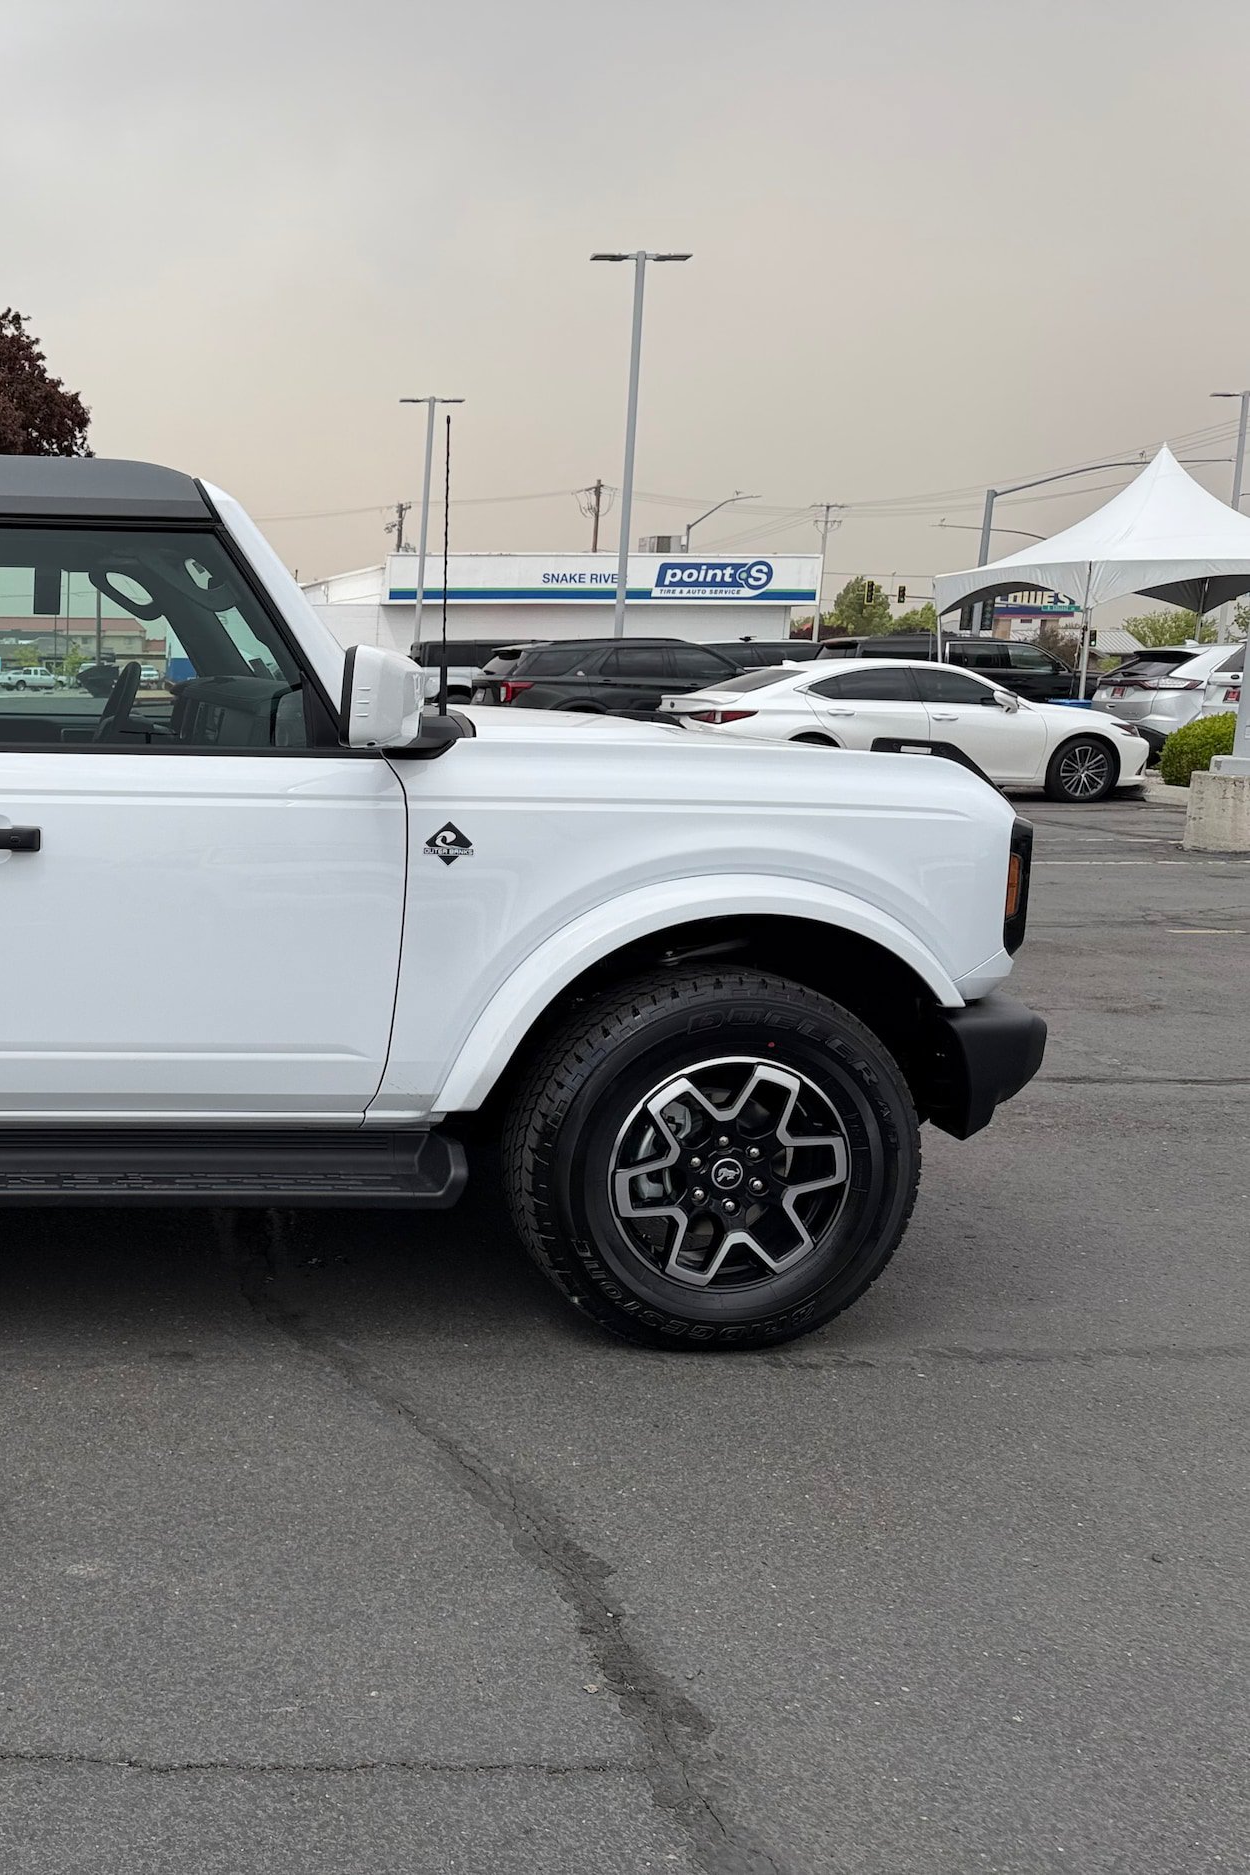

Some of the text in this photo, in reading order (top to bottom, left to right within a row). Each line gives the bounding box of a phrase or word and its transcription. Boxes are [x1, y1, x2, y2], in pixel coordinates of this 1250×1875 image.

[542, 573, 626, 584] SNAKE RIVE
[664, 565, 769, 586] point S
[423, 847, 474, 856] OUTER BANKS
[687, 1007, 880, 1087] DUELER
